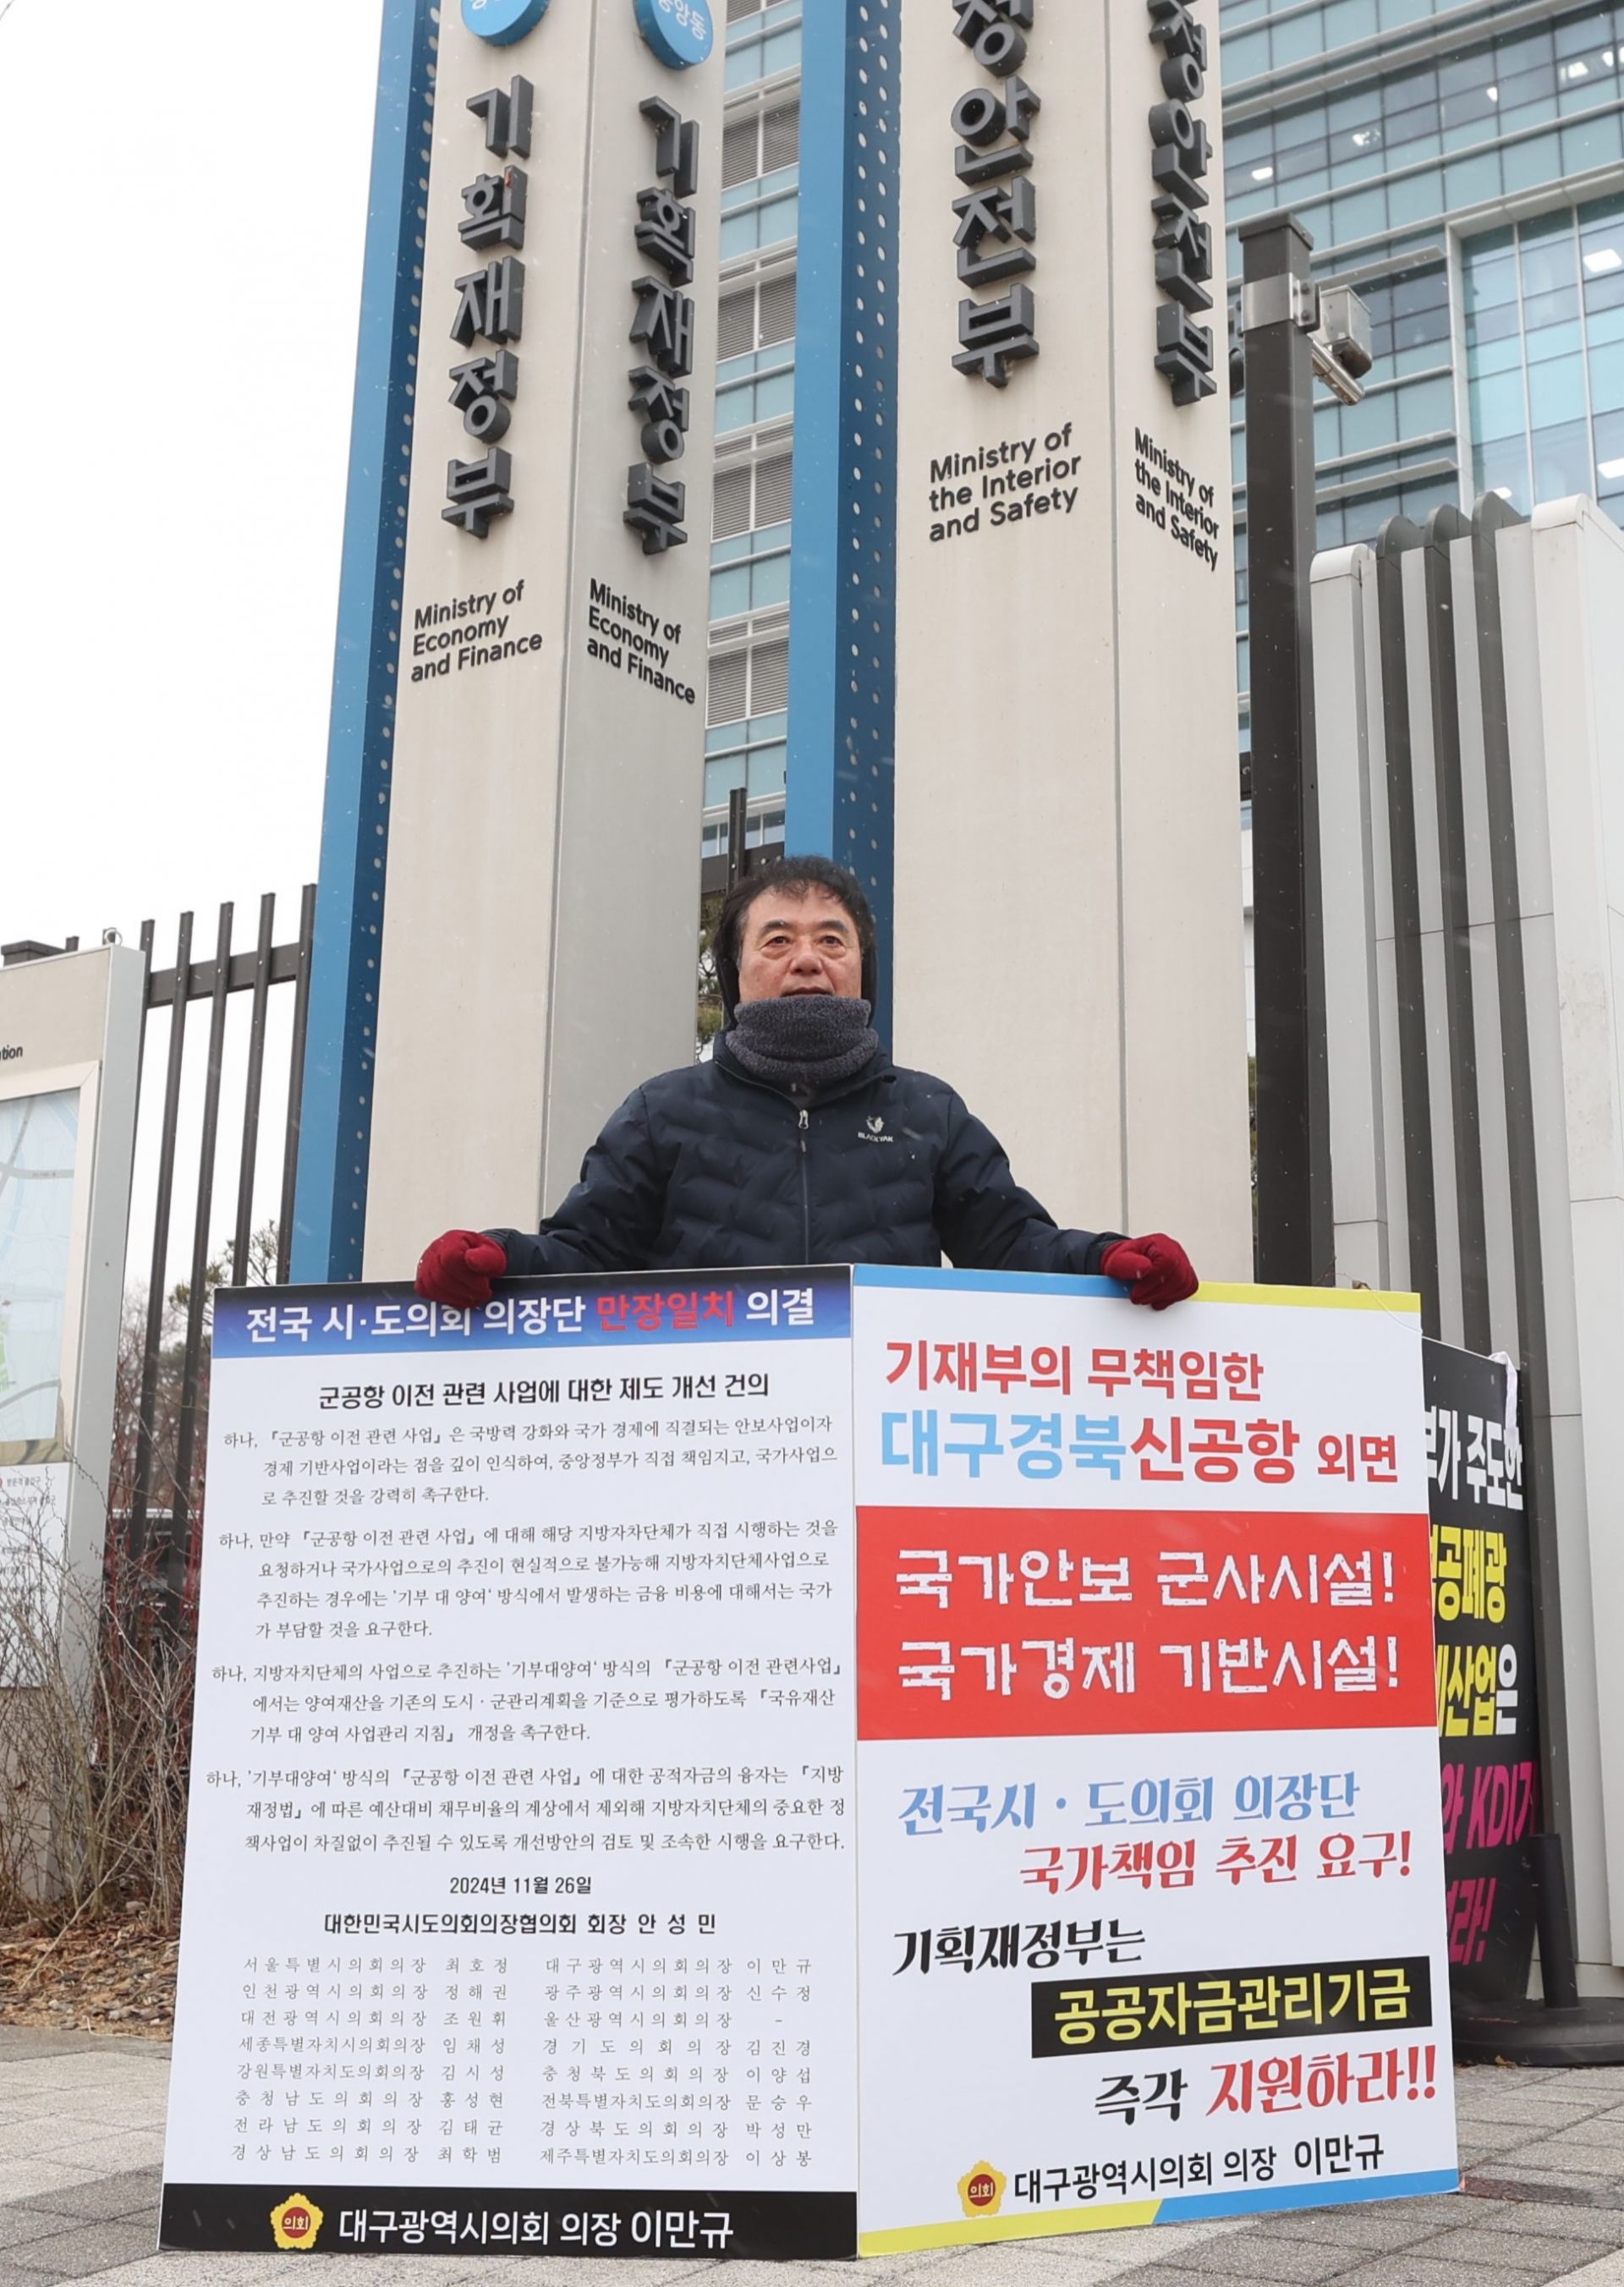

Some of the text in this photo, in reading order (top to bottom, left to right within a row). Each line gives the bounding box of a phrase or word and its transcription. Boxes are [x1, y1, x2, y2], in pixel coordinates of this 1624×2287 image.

[442, 74, 533, 539] 기획재정부
[623, 96, 700, 554] 기획재정부
[930, 421, 1072, 483] Ministry of
[1134, 426, 1215, 508] Ministry of
[929, 455, 1081, 512] the Interior
[930, 486, 1078, 542] and Safety
[1134, 458, 1219, 540] the Interior
[1135, 493, 1218, 572] and Safety
[413, 615, 509, 656] Economy
[414, 579, 524, 630] Ministry of
[590, 578, 681, 644] Ministry of
[411, 633, 542, 682] and Finance
[589, 605, 669, 668] Economy
[587, 637, 695, 705] and Finance
[0, 1044, 23, 1061] tion
[245, 1306, 313, 1342] 전국
[483, 1296, 586, 1335] 의장단
[596, 1291, 735, 1333] 만장일치
[746, 1287, 815, 1326] 의결
[318, 1372, 769, 1410] 군공항 이전 관련 사업에 대한 제도 개선 건의
[886, 1339, 1264, 1401] 기재부의 무책임한
[881, 1410, 1399, 1484] 대구경북신공항 외면
[897, 1549, 1393, 1609] 국가안보 군사시설!
[1429, 1524, 1507, 1623] 공폐광
[898, 1635, 1399, 1701] 국가경제 기반시설!
[1084, 1776, 1214, 1827] 도의회
[1233, 1771, 1360, 1823] 의장단
[449, 1876, 591, 1895] 2024년 11월 26일
[1020, 1830, 1411, 1895] 국가책임 추진 요구!
[324, 1912, 627, 1935] 대한민국시도의회의장협의회 회장
[892, 1918, 1145, 1977] 기획재정부는
[1446, 1877, 1498, 1965] 라!
[1054, 1968, 1411, 2045] 공공자금관리기금
[1095, 2044, 1436, 2125] 즉각 지원하라!!
[970, 2184, 993, 2199] 의회
[1014, 2133, 1384, 2203] 대구광역시의회 의장 이만규
[283, 2215, 310, 2232] 의회
[339, 2210, 734, 2251] 대구광역시의회 의장 이만규
